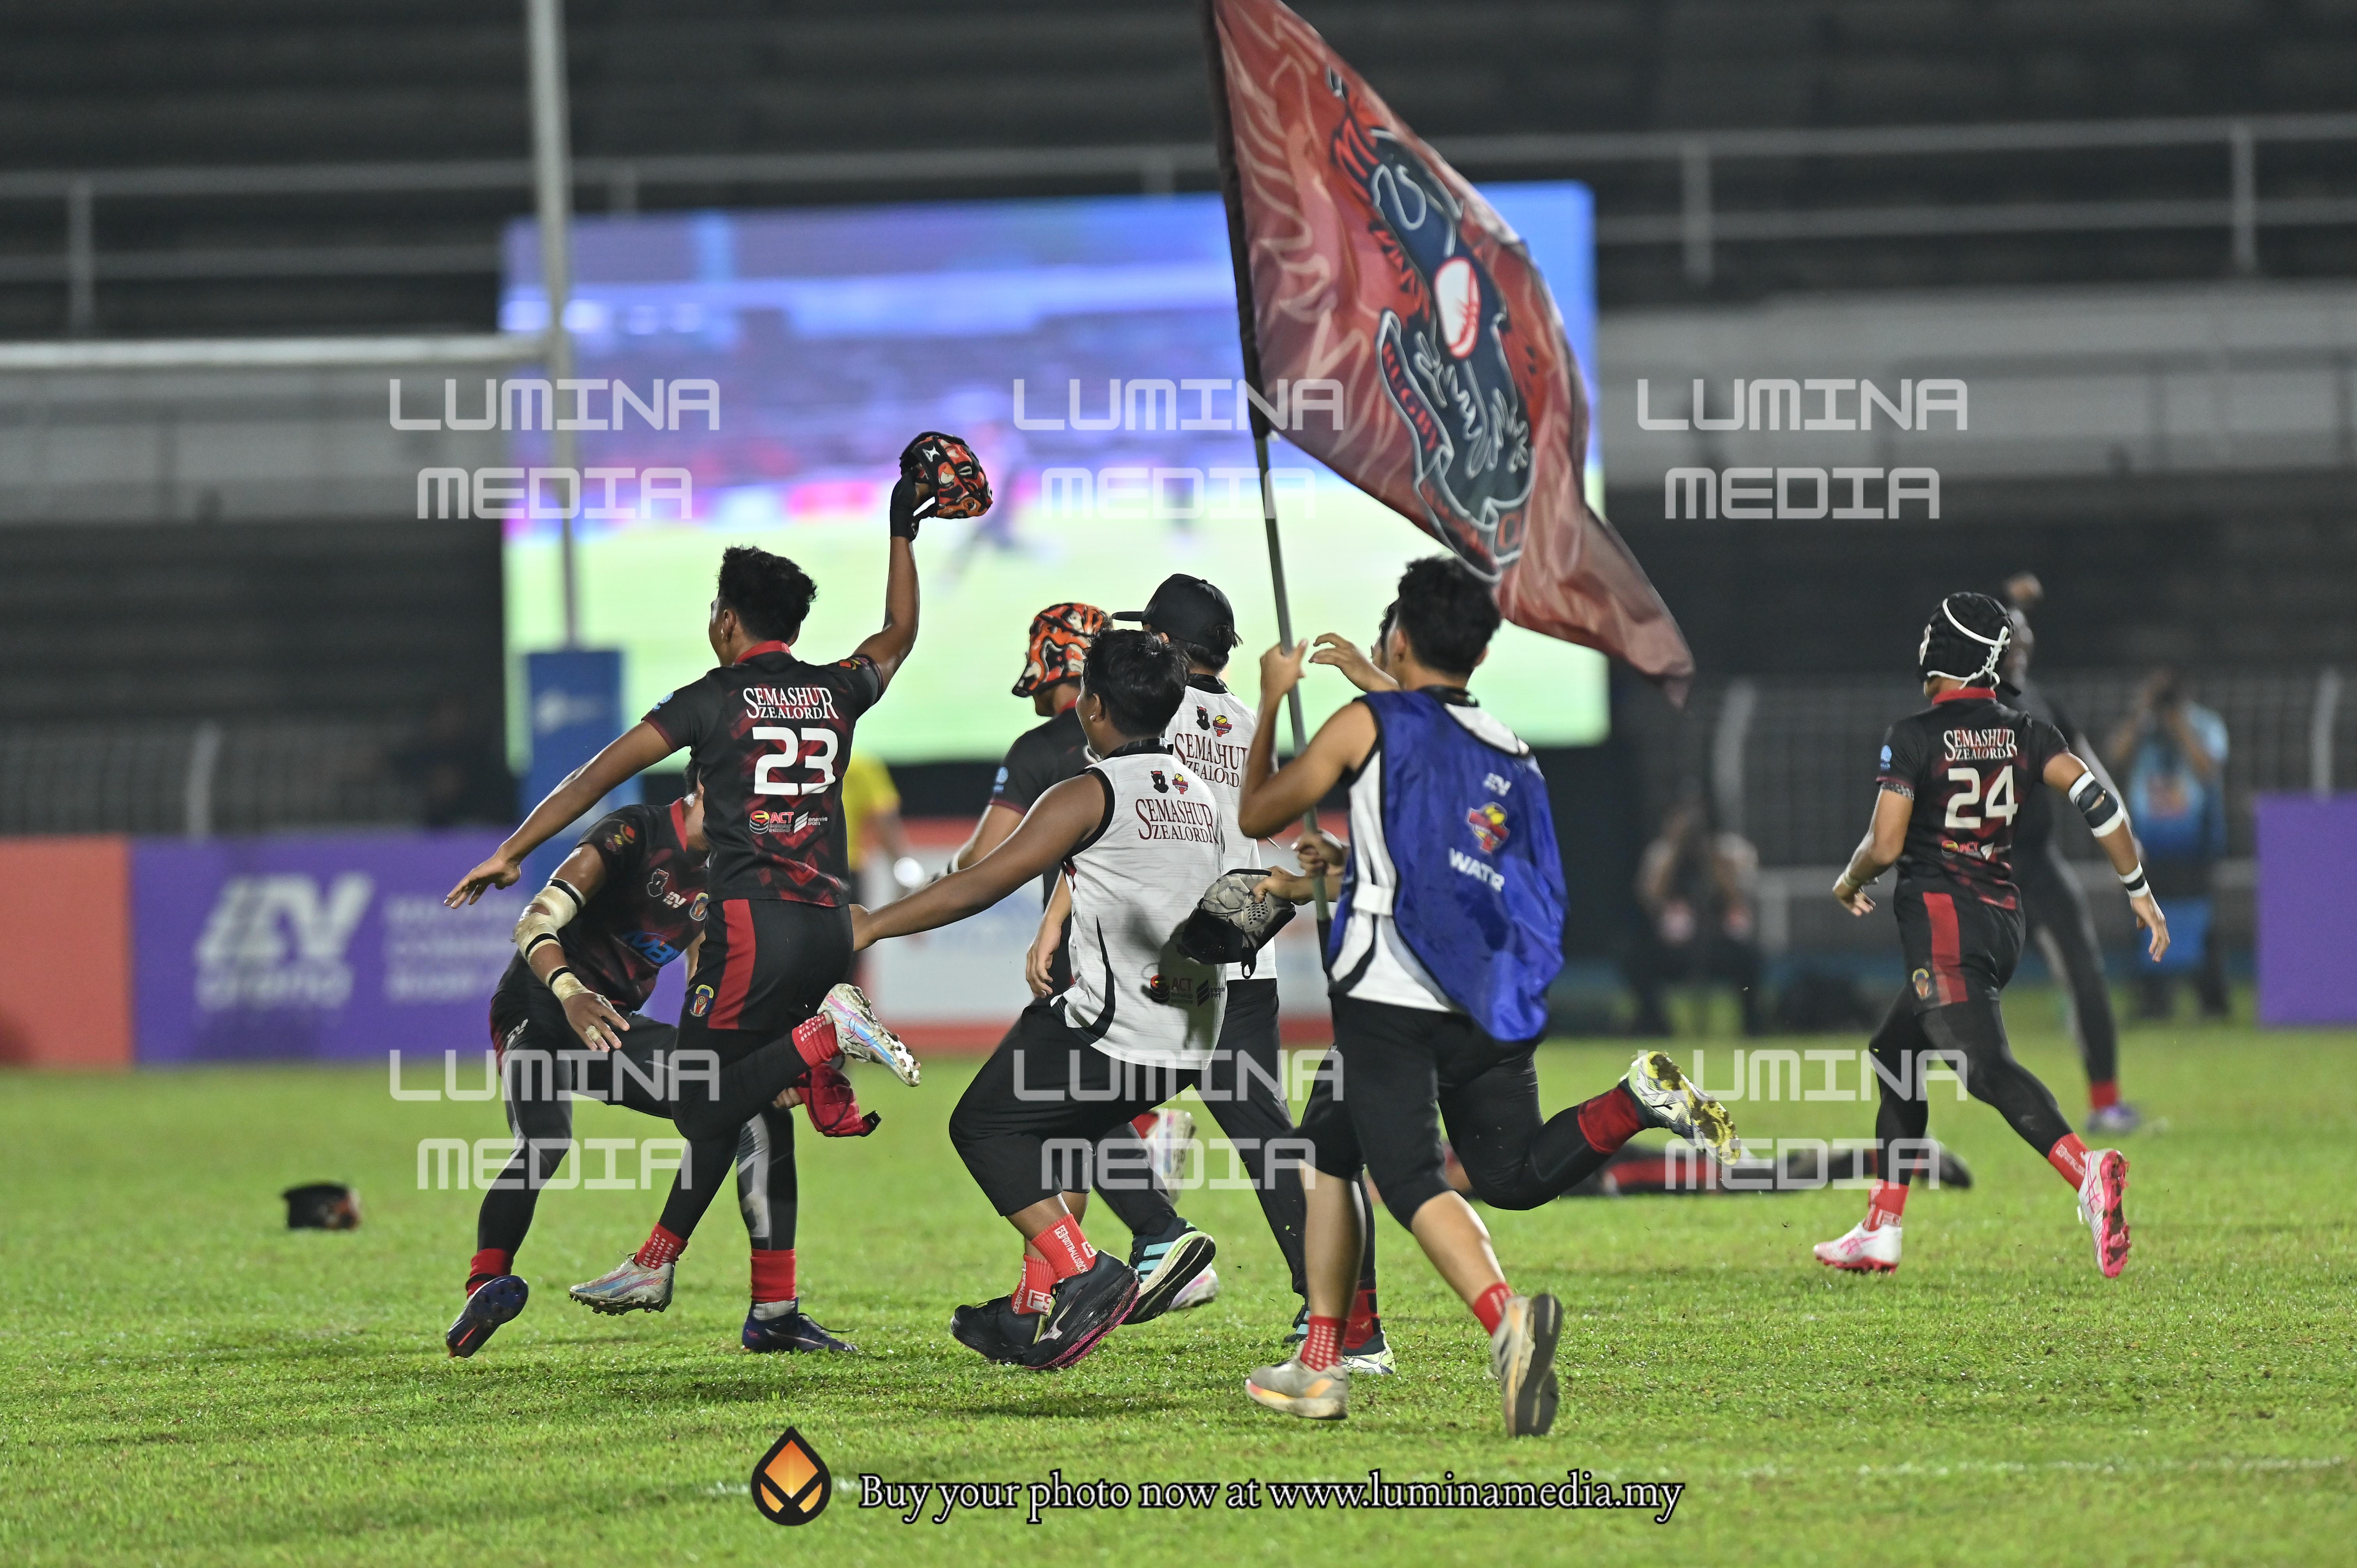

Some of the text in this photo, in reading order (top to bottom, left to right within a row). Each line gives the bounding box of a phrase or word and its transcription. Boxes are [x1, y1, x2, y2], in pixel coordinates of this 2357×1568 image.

[743, 687, 839, 719] SEMASHUR
[759, 706, 822, 719] ZEALORD
[1175, 733, 1248, 772] SEMASHU
[1944, 729, 2018, 761] SEMASHUR
[1956, 747, 2006, 760] ZEALORD
[752, 727, 838, 795] 23
[1945, 765, 2018, 829] 24
[770, 811, 794, 824] ACT
[1135, 798, 1219, 844] SEMASHUR
[1152, 824, 1209, 843] ZEALORD
[1171, 977, 1193, 991] ACT
[1056, 1227, 1066, 1236] FS
